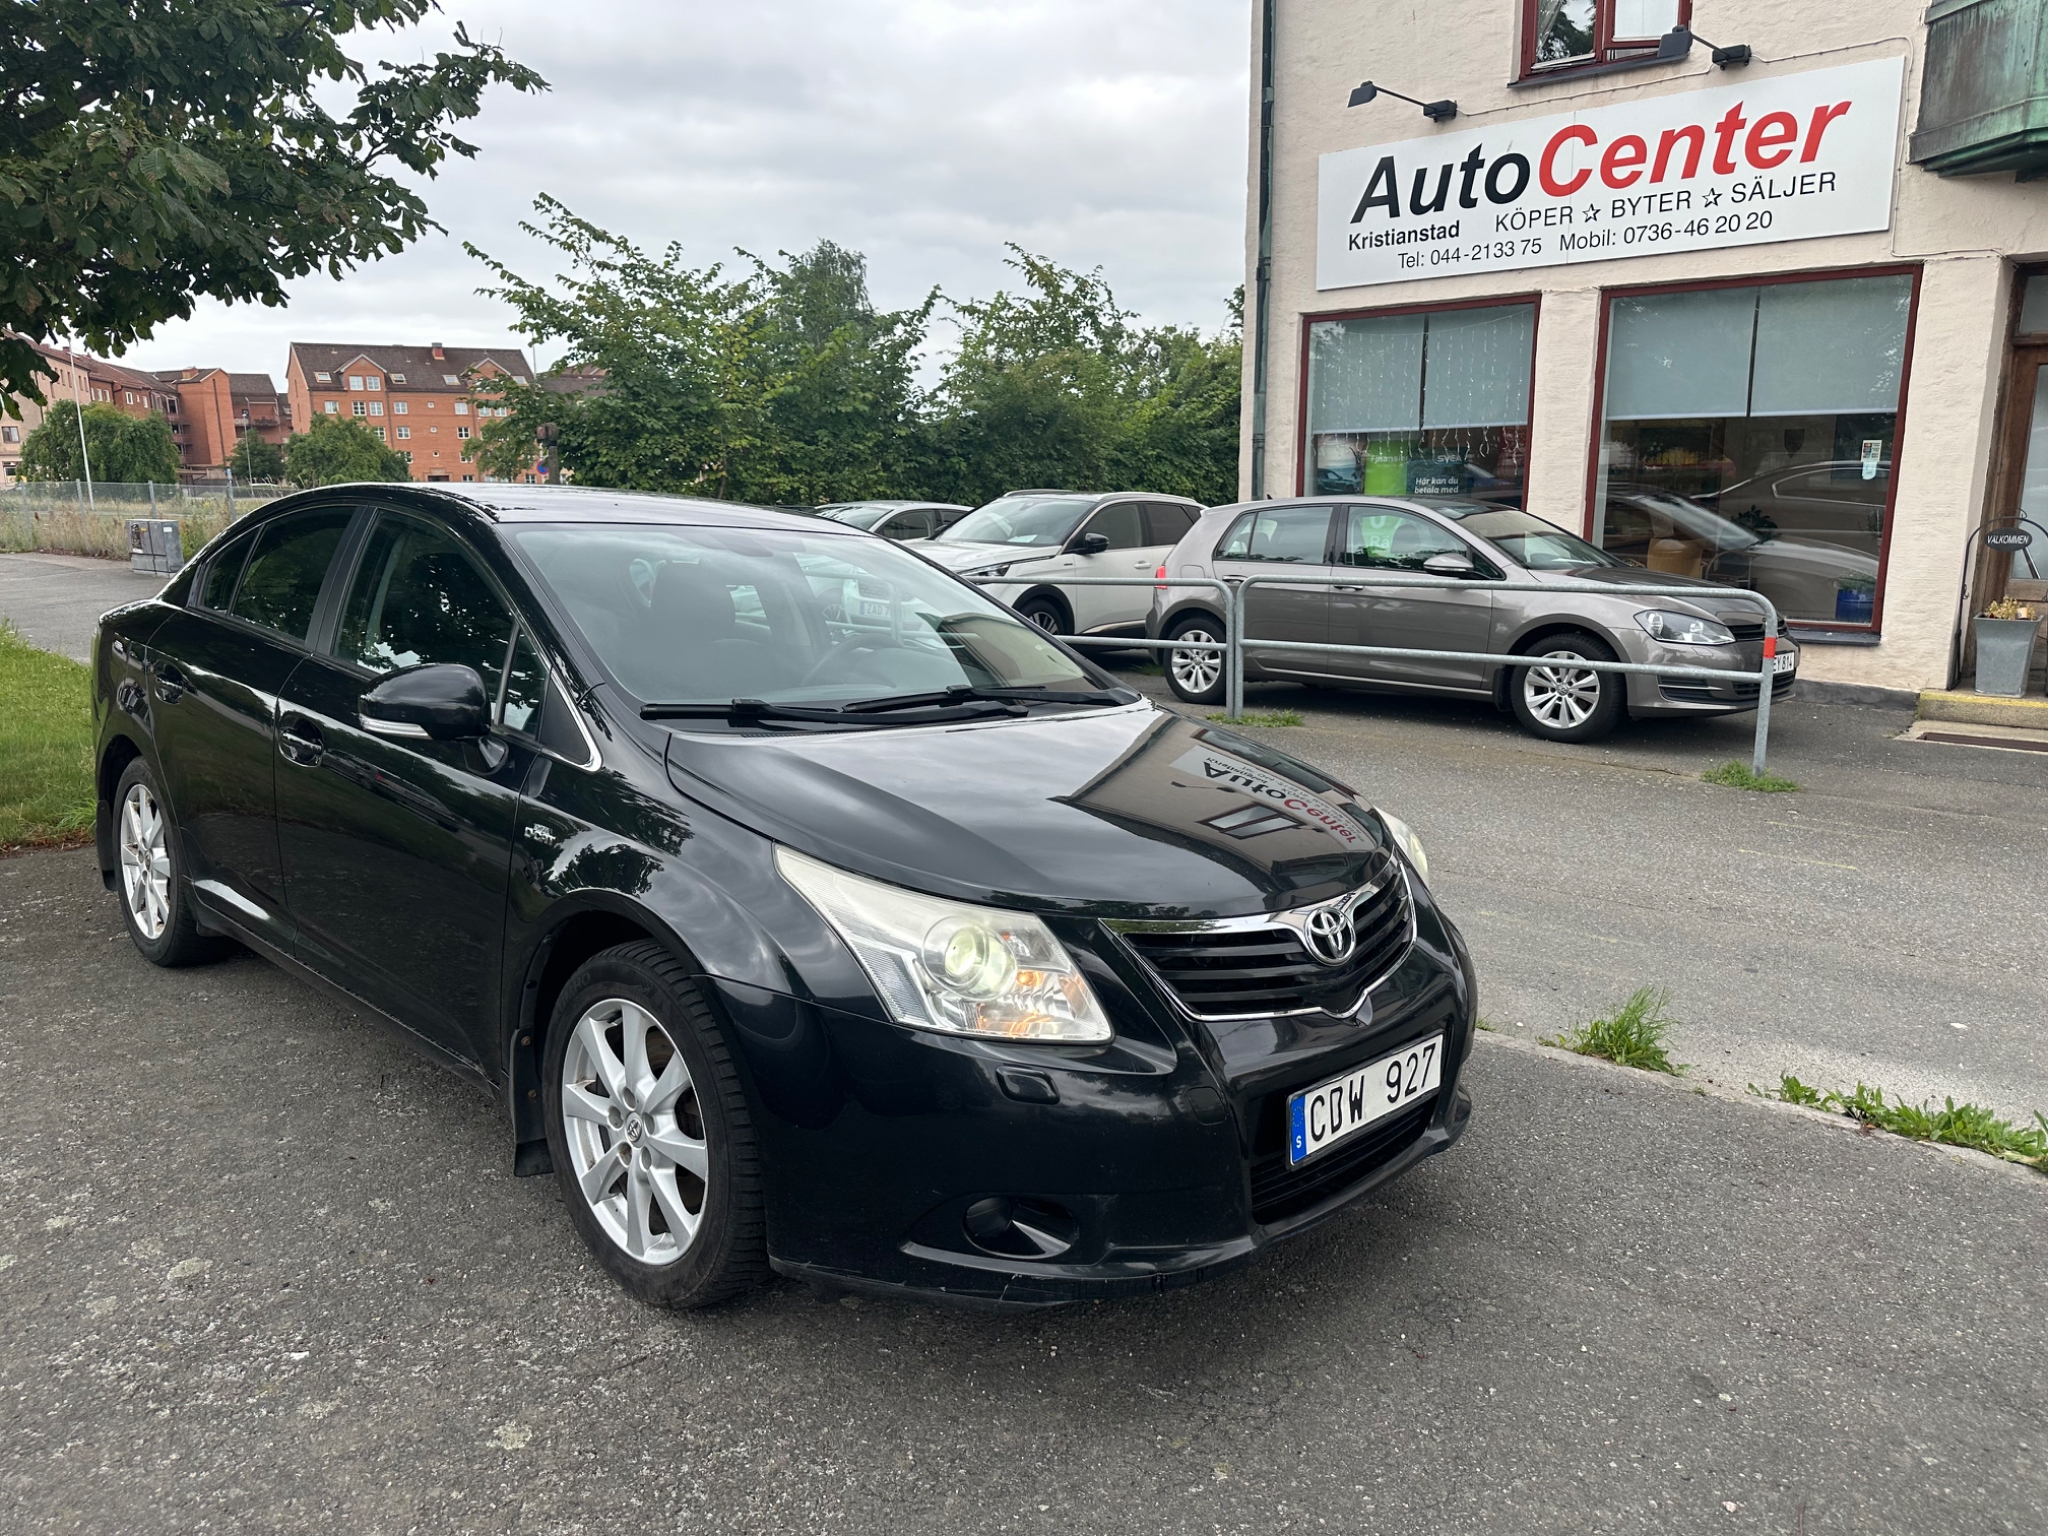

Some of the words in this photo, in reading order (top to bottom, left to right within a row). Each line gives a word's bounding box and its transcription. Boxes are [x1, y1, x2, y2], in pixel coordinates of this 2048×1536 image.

[1495, 206, 1574, 233] KÖPER
[1611, 189, 1692, 218] BYTER
[1730, 171, 1837, 203] SÄLJER
[1348, 220, 1460, 251] Kristianstad
[1398, 251, 1425, 269] Tel:
[1560, 229, 1616, 251] Mobil:
[1714, 213, 1742, 234] 20
[1746, 210, 1773, 231] 20
[1414, 484, 1439, 494] betala
[1441, 485, 1459, 493] med
[1431, 477, 1447, 485] kan
[1449, 476, 1459, 485] du
[1309, 1075, 1365, 1142] CDW
[1386, 1042, 1437, 1104] 927
[1295, 1135, 1302, 1149] S
